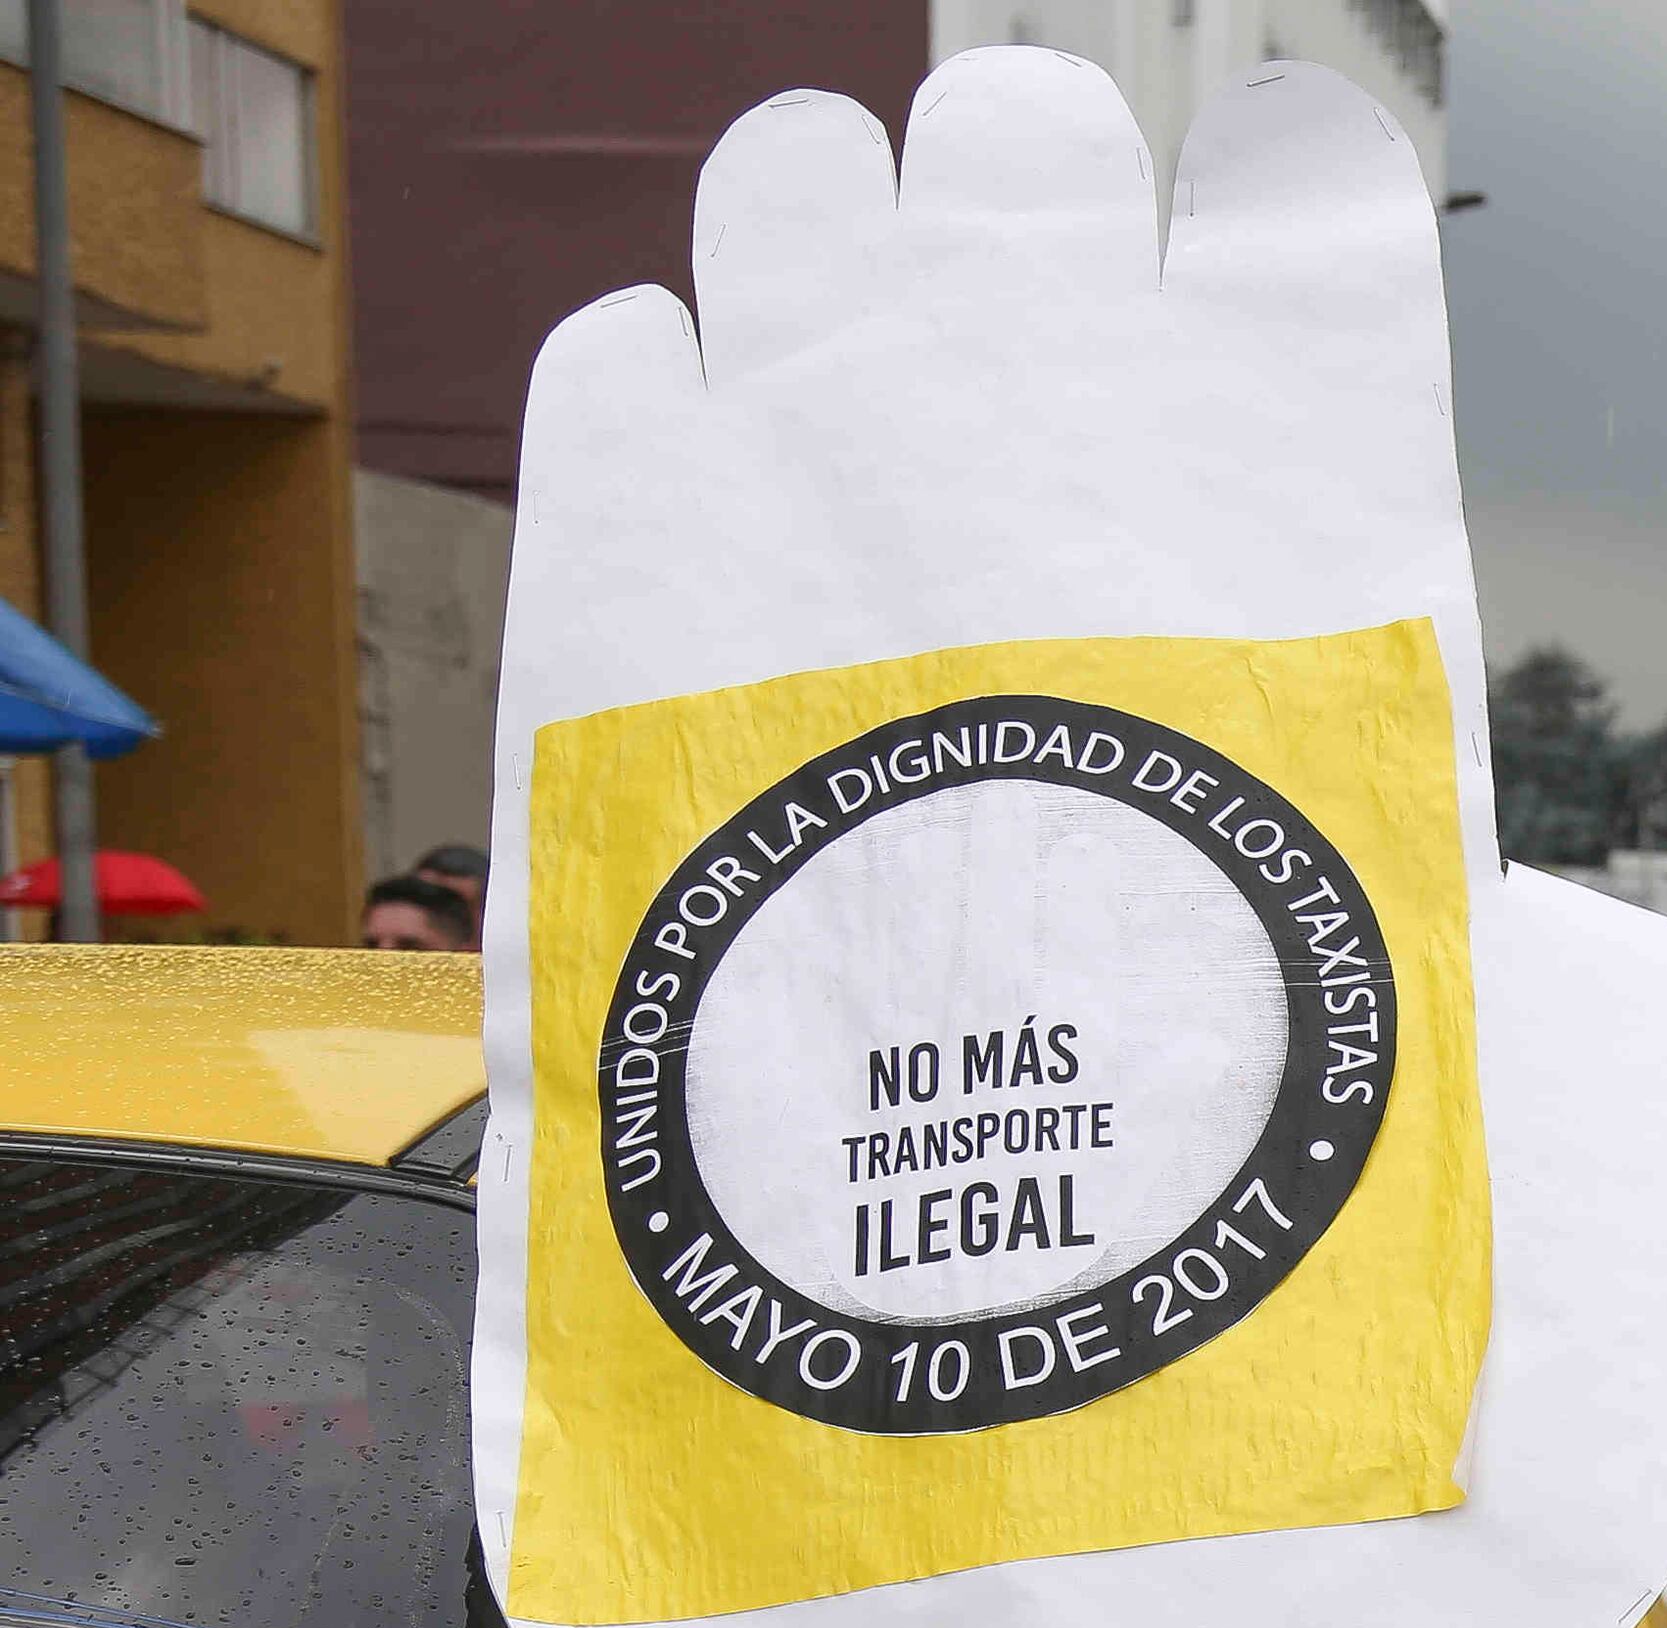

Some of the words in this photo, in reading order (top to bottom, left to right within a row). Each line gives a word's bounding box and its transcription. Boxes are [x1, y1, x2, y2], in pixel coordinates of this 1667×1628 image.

[616, 970, 681, 1192] UNIDOS
[655, 856, 762, 960] POR
[747, 803, 828, 865] LA
[828, 722, 1125, 814] DIGNIDAD
[1132, 751, 1220, 814] DE
[1208, 797, 1313, 884] LOS
[1288, 876, 1379, 1106] TAXISTAS
[868, 1042, 940, 1111] NO
[963, 1015, 1080, 1096] MÁS
[842, 1102, 1115, 1183] TRANSPORTE
[854, 1174, 1096, 1277] ILEGAL
[662, 1232, 861, 1391] MAYO
[891, 1341, 970, 1402] 10
[998, 1302, 1121, 1391] DE
[1132, 1177, 1295, 1336] 2017
